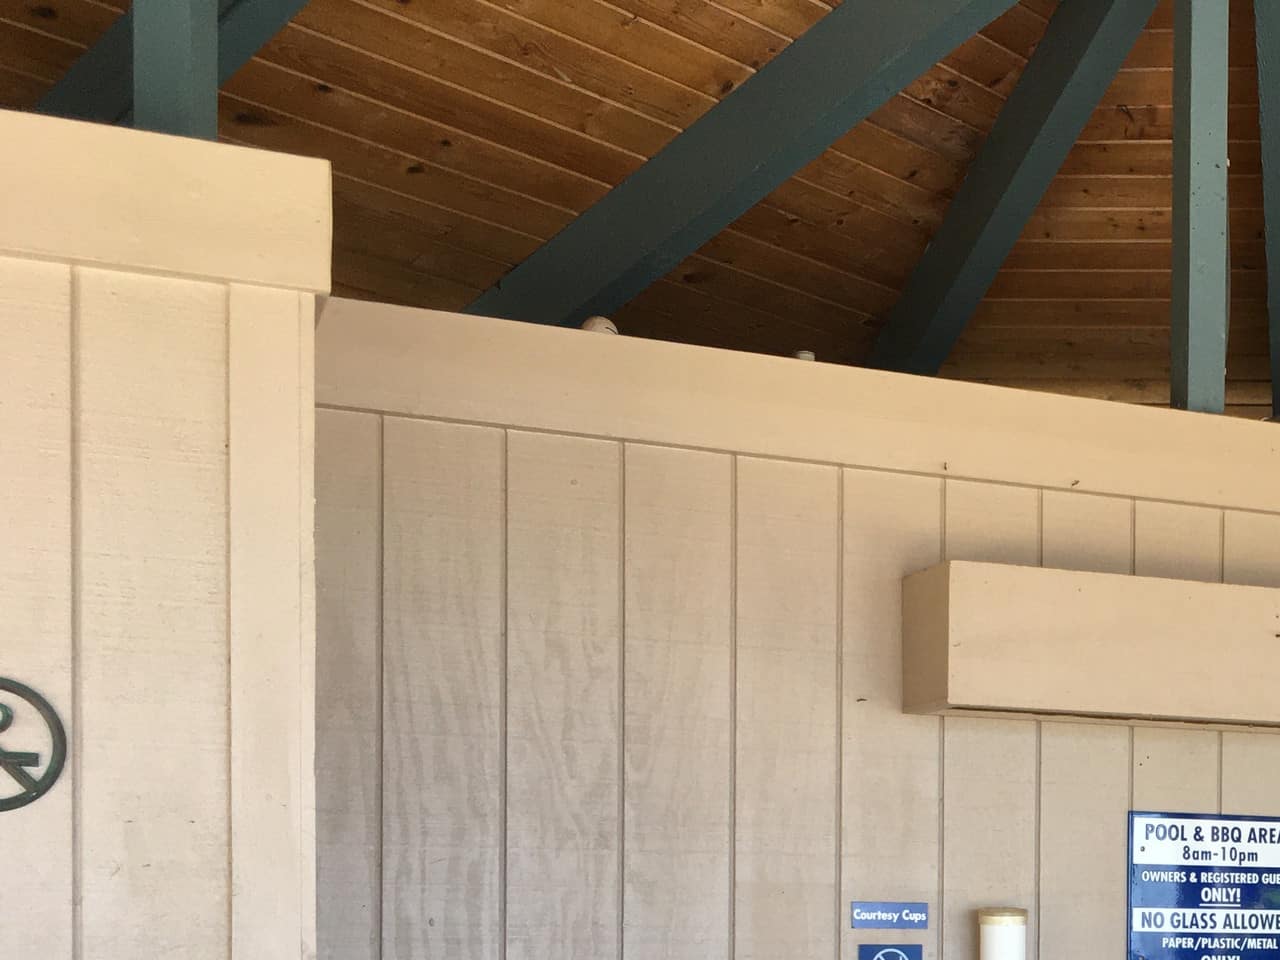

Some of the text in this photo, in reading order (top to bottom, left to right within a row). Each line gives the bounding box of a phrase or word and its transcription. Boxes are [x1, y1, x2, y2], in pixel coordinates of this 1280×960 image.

[1145, 824, 1187, 841] POOL
[1193, 825, 1204, 842] &
[1211, 826, 1242, 843] BBQ
[1182, 845, 1258, 865] 8am-10pm
[1142, 870, 1187, 883] OWNERS
[1189, 872, 1198, 883] &
[1200, 872, 1259, 884] REGISTERED
[1200, 888, 1241, 903] ONLY!
[853, 908, 927, 923] Courtesy Cups
[1141, 912, 1165, 928] NO
[1170, 912, 1217, 929] GLASS
[1161, 937, 1278, 950] PAPER/PLASTIC/METAL
